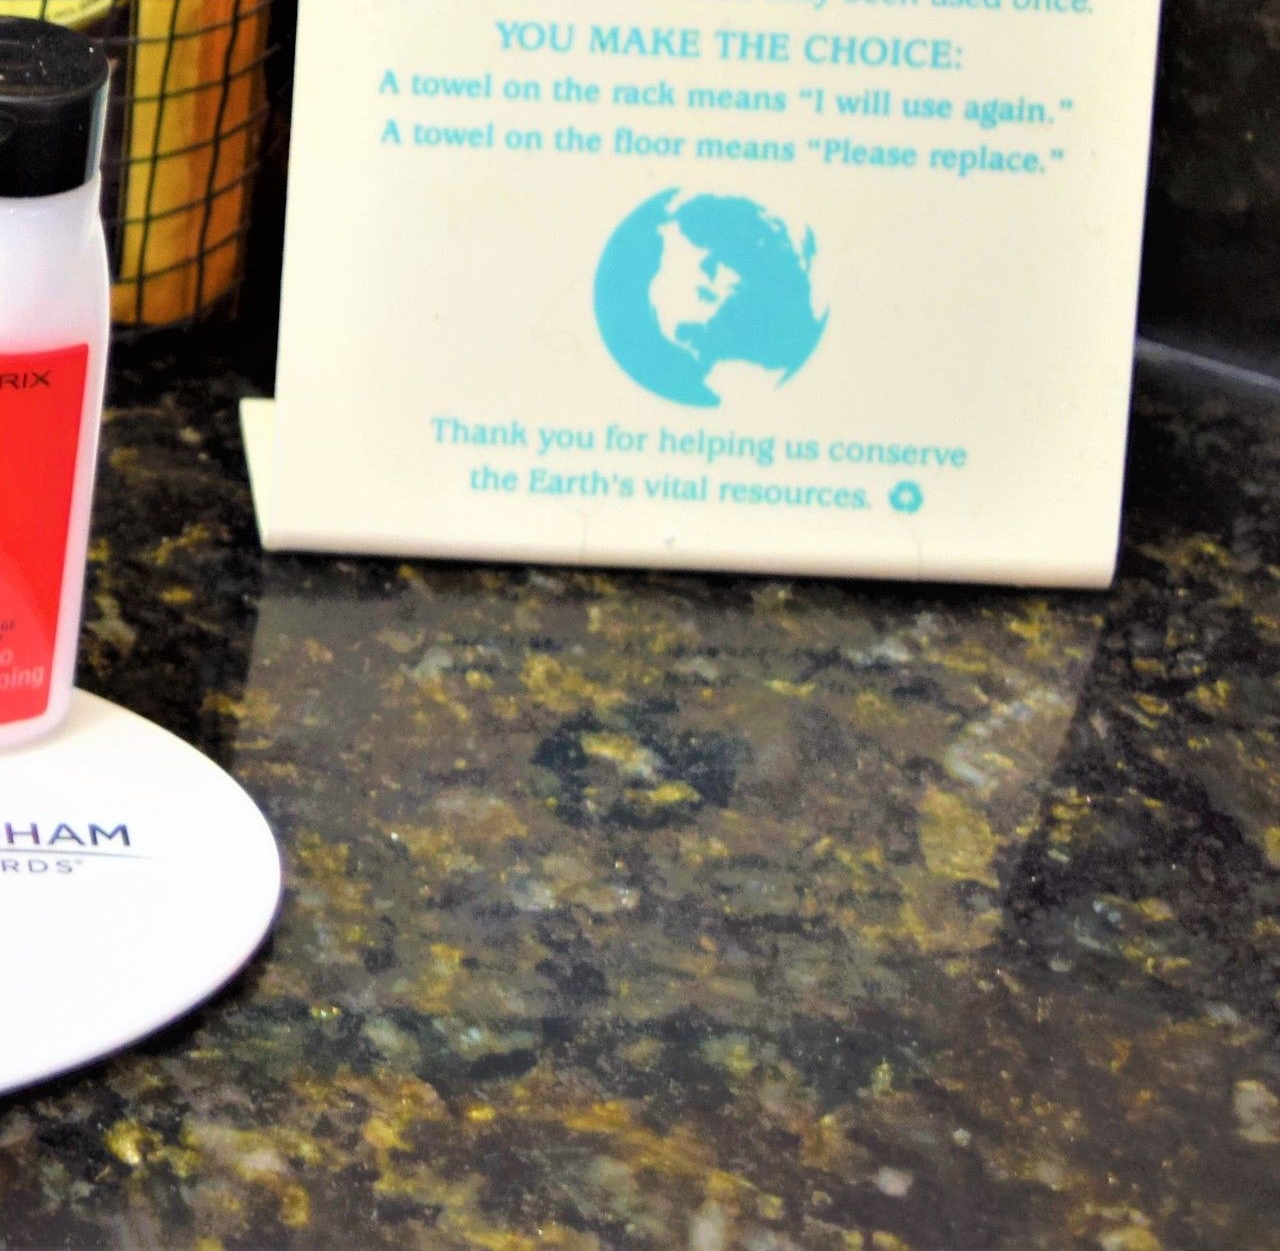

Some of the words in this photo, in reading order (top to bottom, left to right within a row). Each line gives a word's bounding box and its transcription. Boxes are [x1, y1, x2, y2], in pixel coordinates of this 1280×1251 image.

[494, 19, 575, 54] YOU
[588, 23, 701, 59] MAKE
[713, 29, 790, 63] THE
[802, 32, 962, 70] CHOICE:
[378, 68, 400, 95] A
[410, 71, 493, 99] towel
[501, 78, 542, 101] on
[551, 75, 601, 104] the
[611, 79, 676, 108] rack
[686, 86, 788, 113] means
[798, 87, 825, 114] "I
[834, 88, 892, 117] will
[900, 96, 954, 120] use
[962, 95, 1073, 131] again."
[379, 117, 402, 146] A
[412, 121, 495, 149] towel
[503, 128, 544, 151] on
[552, 124, 603, 154] the
[612, 125, 687, 157] floor
[694, 136, 796, 163] means
[806, 137, 918, 168] "Please
[927, 143, 1065, 178] replace."
[429, 414, 528, 447] Thank
[536, 426, 596, 457] you
[603, 422, 649, 453] for
[656, 426, 777, 468] helping
[783, 438, 821, 462] us
[826, 440, 969, 470] conserve
[468, 463, 519, 493] the
[527, 466, 635, 499] Earth's
[642, 474, 709, 503] vital
[717, 480, 871, 510] resources.
